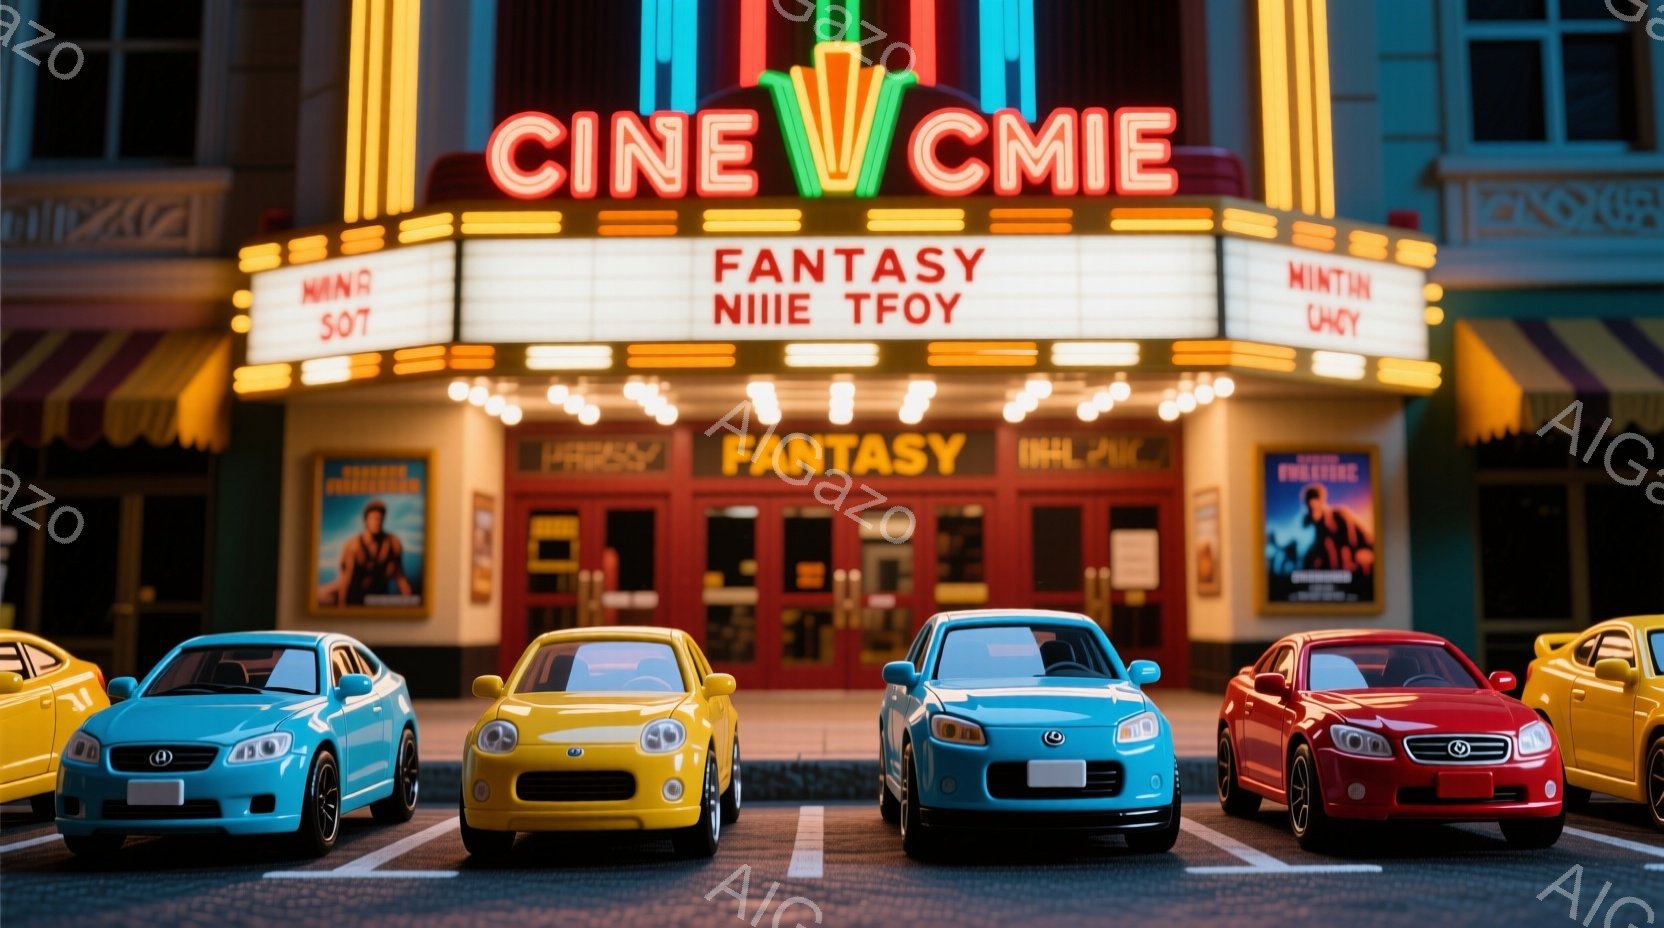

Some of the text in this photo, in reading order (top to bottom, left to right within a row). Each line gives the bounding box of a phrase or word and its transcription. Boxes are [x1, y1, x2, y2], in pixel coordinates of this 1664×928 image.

[486, 107, 1179, 199] CINE CMIE
[714, 247, 985, 284] FANTASY
[714, 292, 961, 325] NIIIE TFOY
[721, 432, 968, 476] FANTASY
